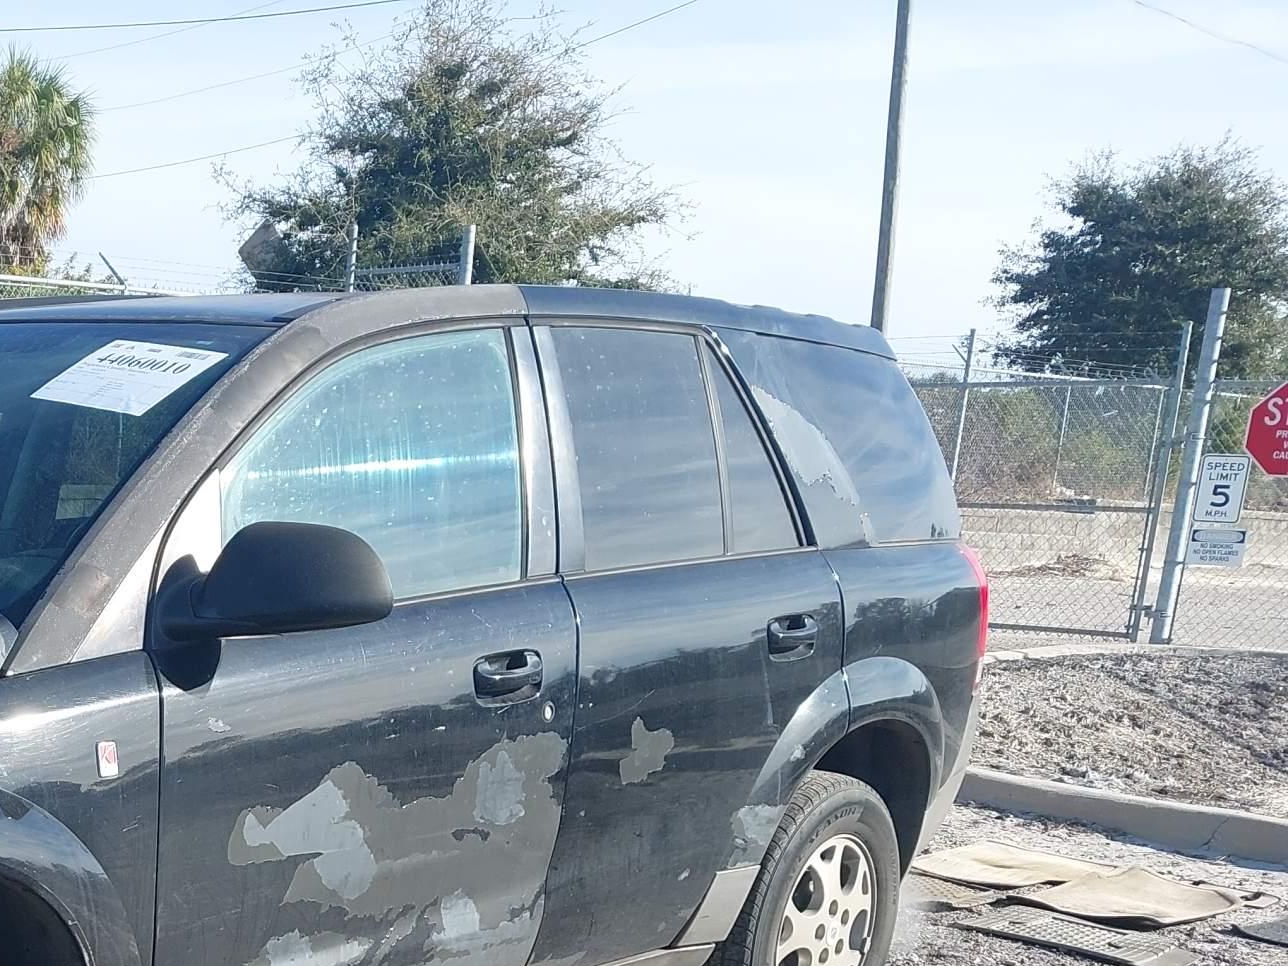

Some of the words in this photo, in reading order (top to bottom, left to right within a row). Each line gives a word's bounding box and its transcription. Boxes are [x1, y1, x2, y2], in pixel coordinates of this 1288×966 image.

[97, 352, 191, 374] 44060010
[1206, 461, 1245, 472] SPEED
[1208, 472, 1240, 482] LIMIT
[1209, 484, 1231, 508] 5
